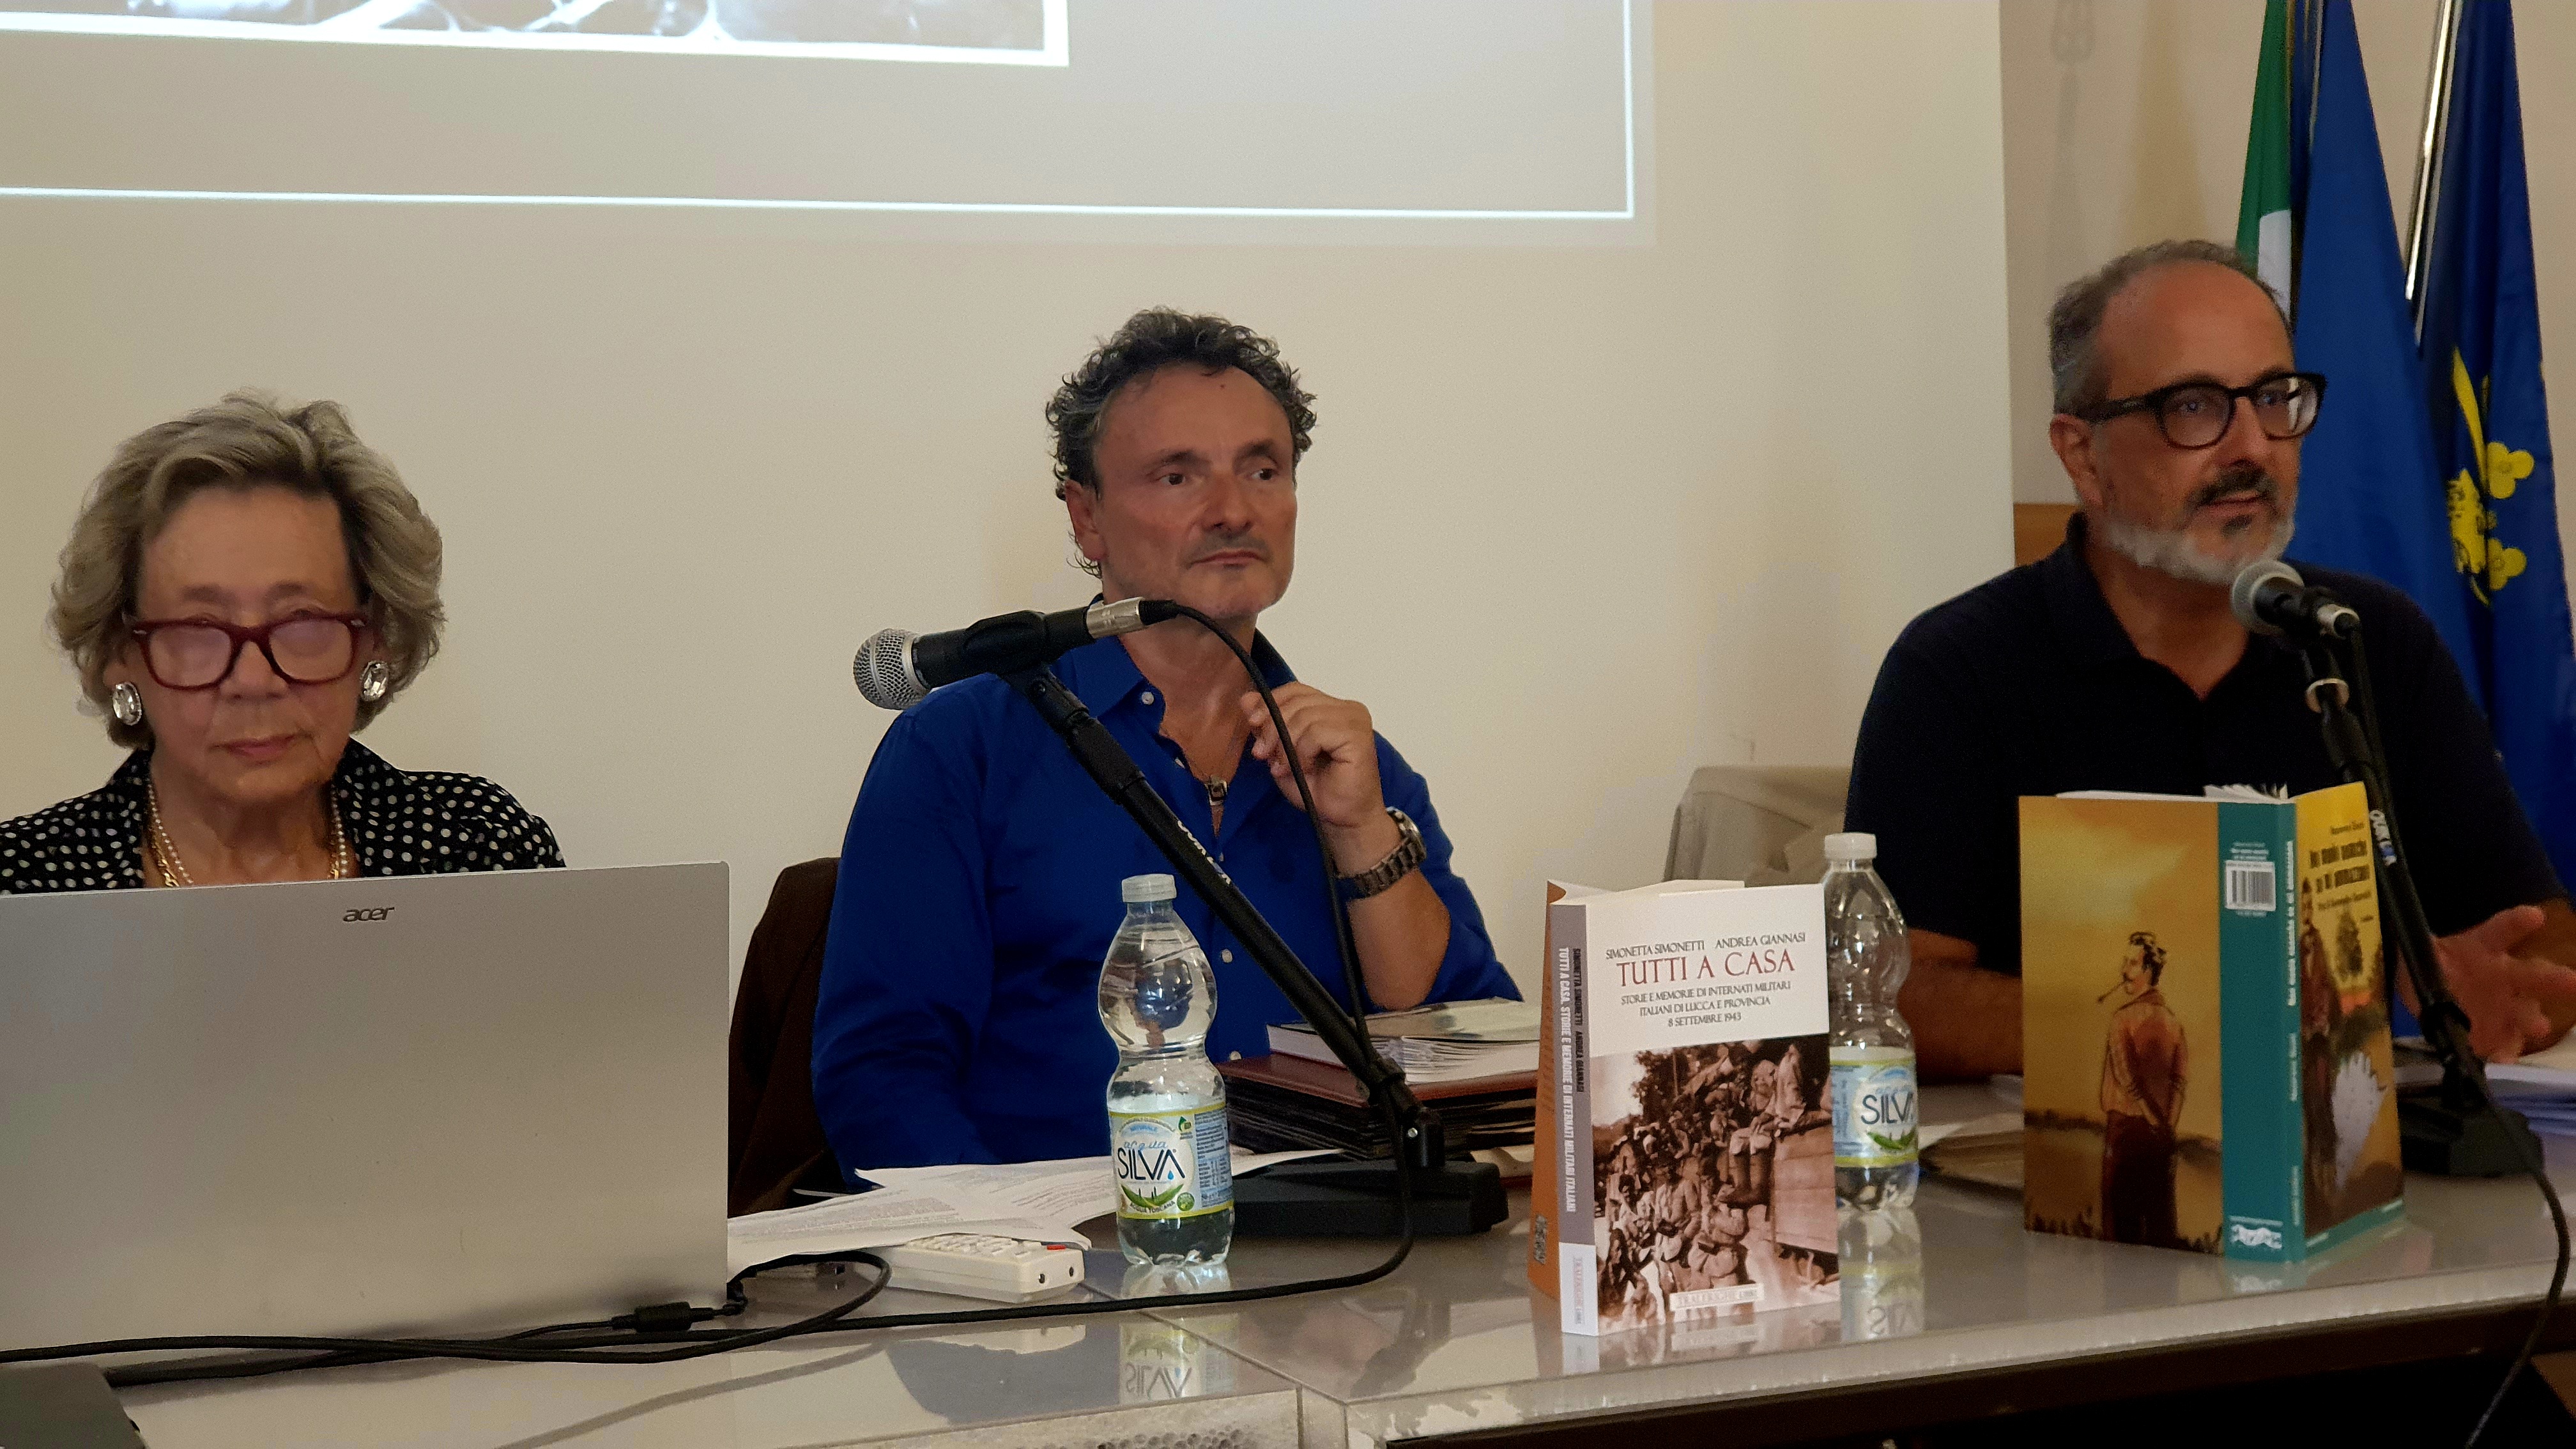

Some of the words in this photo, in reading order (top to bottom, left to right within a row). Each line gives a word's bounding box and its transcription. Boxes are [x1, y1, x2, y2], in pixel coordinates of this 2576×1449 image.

[343, 907, 395, 921] acer
[1606, 944, 1653, 959] SIMONETTA
[1655, 940, 1705, 954] SIMONETTI
[1715, 936, 1758, 949] ANDREA
[1760, 932, 1805, 945] GIANNASI
[1559, 947, 1570, 971] TUTTI
[1616, 956, 1687, 986] TUTTI
[1696, 955, 1715, 979] A
[1724, 948, 1795, 976] CASA
[1621, 993, 1648, 1005] STORIE
[1649, 992, 1655, 1001] E
[1656, 989, 1694, 1001] MEMORIE
[1696, 988, 1707, 997] DI
[1708, 984, 1753, 996] INTERNATI
[1755, 981, 1791, 992] MILITARI
[1639, 1006, 1673, 1016] ITALIANI
[1674, 1004, 1685, 1013] DI
[1687, 1000, 1715, 1013] LUCCA
[1717, 999, 1723, 1009] E
[1724, 997, 1771, 1009] PROVINCIA
[1561, 1006, 1572, 1036] STORIE
[1668, 1018, 1674, 1027] 8
[1675, 1013, 1724, 1027] SETTEMBRE
[1724, 1012, 1742, 1022] 1943
[1562, 1045, 1572, 1084] MEMORIE
[1563, 1085, 1573, 1094] DI
[1117, 1147, 1185, 1181] SILVA
